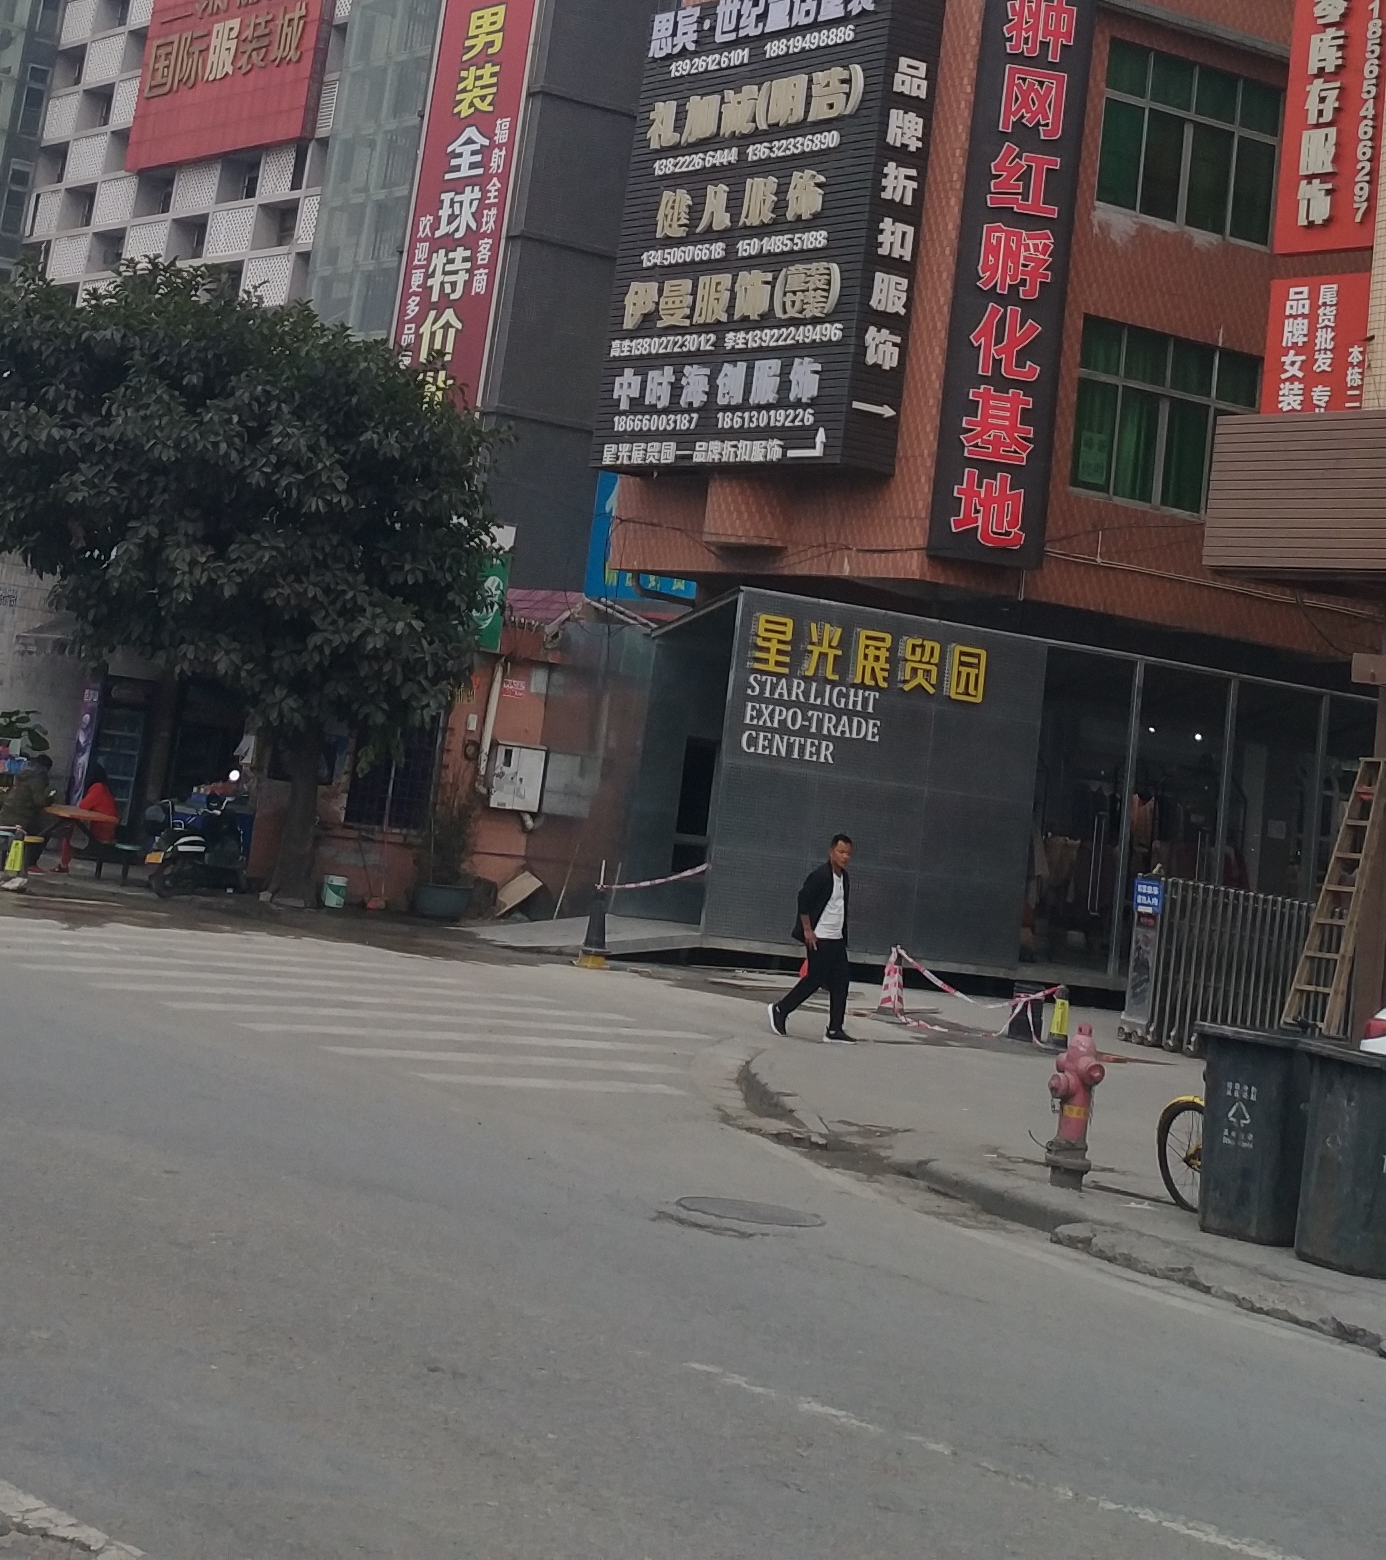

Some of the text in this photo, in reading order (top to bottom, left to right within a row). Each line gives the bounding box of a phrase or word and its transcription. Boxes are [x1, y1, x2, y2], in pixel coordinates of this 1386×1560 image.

[142, 0, 309, 99] 国际服装城
[669, 24, 856, 78] 13926126101 18819498886
[470, 116, 512, 296] 辐射全球客商
[864, 56, 928, 372] 品牌折扣服饰
[1277, 285, 1311, 413] 品牌女装
[612, 408, 814, 432] 18666003187 18613019226
[752, 612, 988, 704] 星光展贸园
[740, 730, 835, 765] CENTER
[743, 701, 881, 743] EXPO-TRADE
